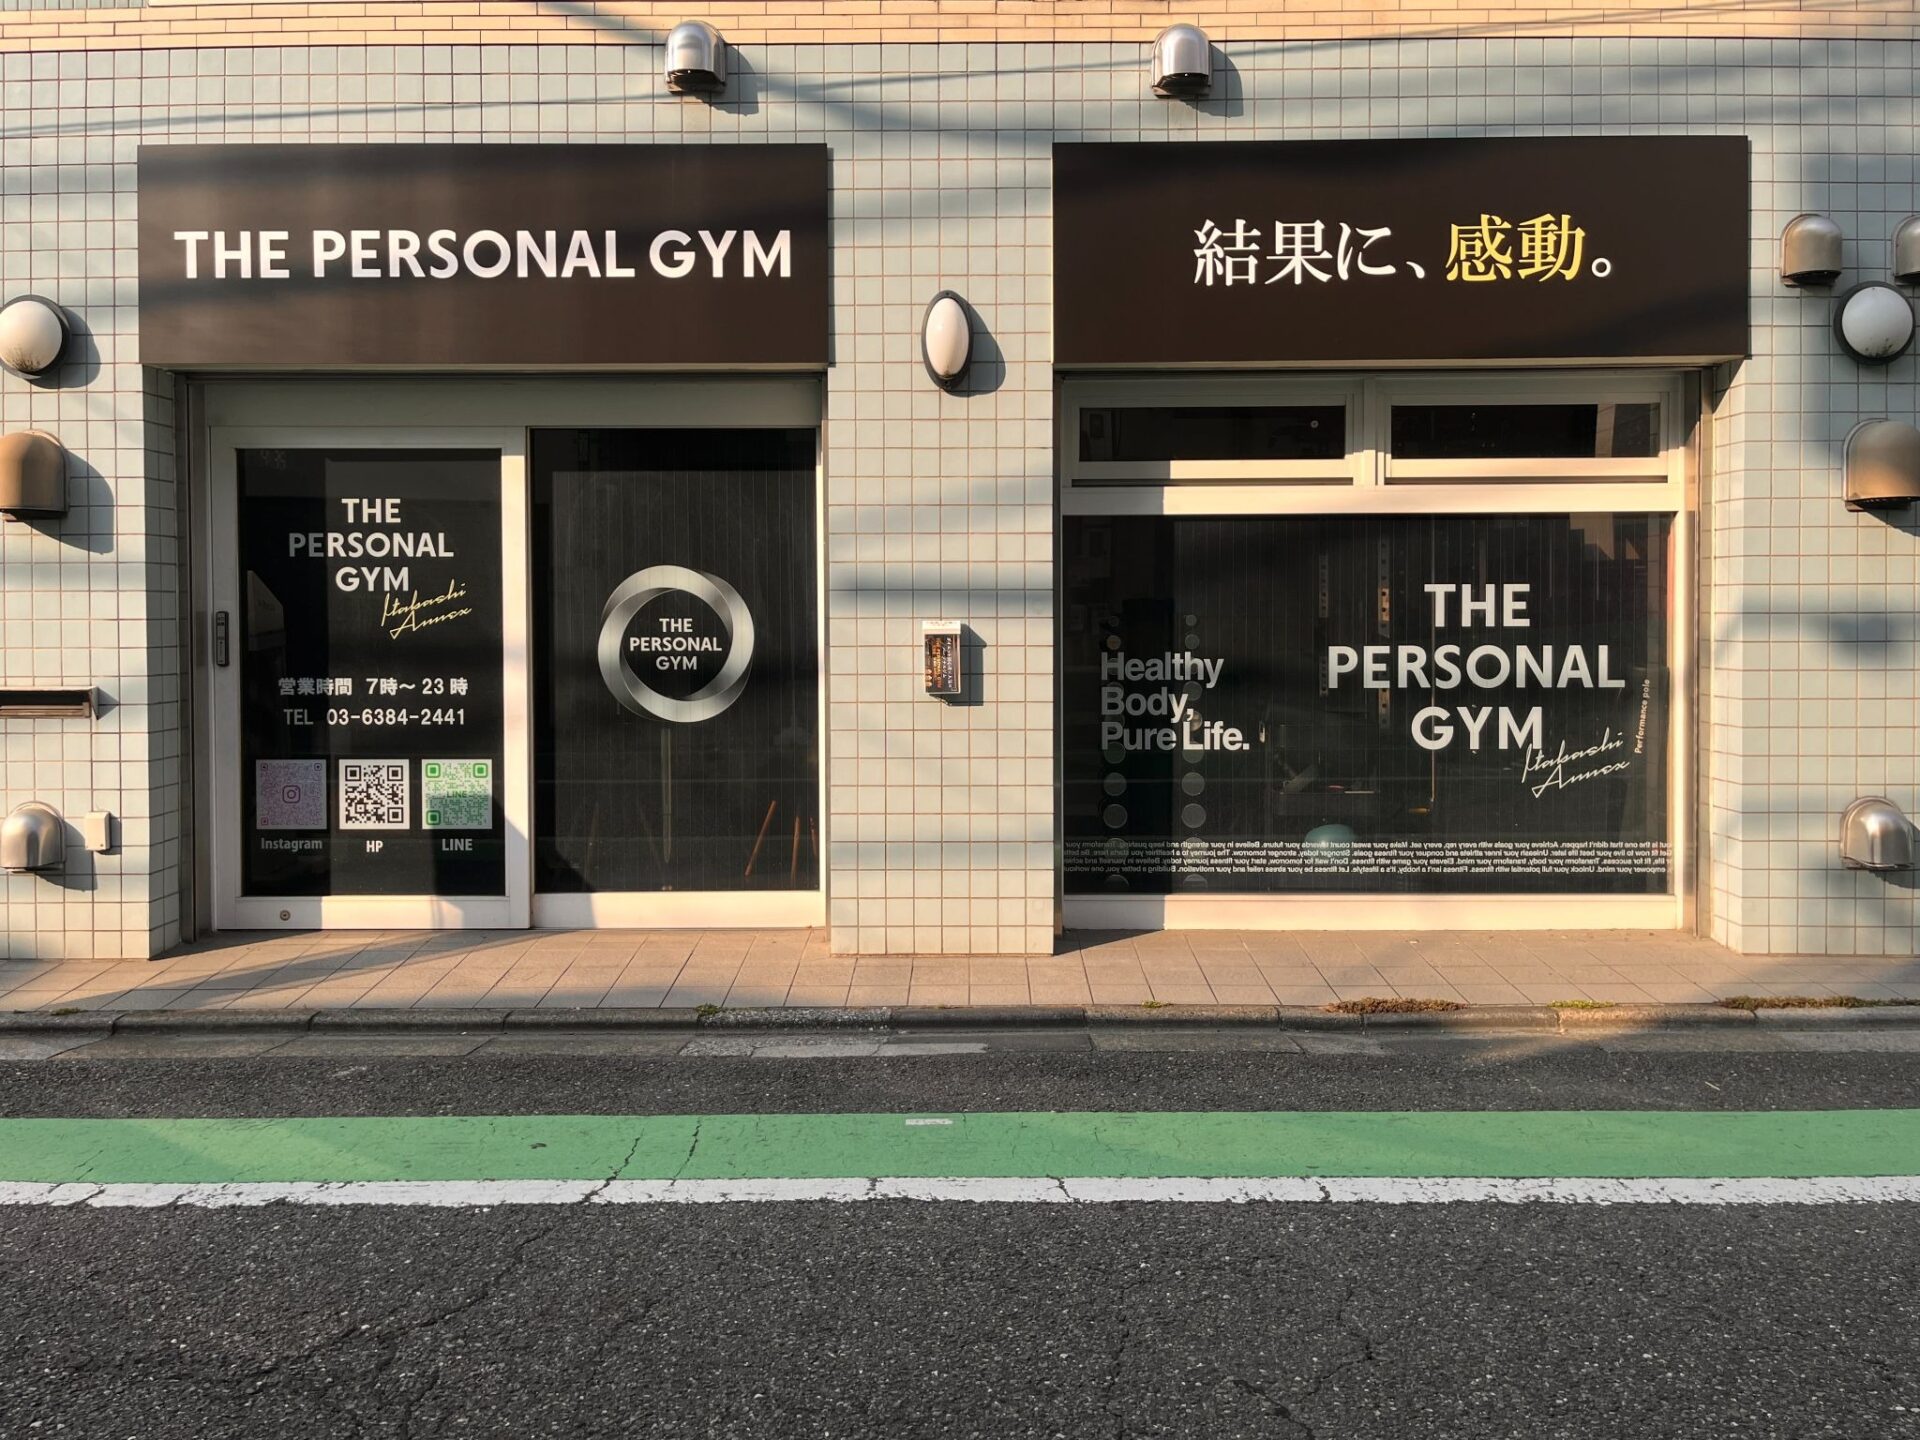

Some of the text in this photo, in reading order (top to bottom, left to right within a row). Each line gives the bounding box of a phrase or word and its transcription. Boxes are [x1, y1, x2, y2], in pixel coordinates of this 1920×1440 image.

[174, 230, 790, 278] THE PERSONAL GYM
[1194, 214, 1611, 286] 結果に、感動。
[342, 499, 401, 523] THE
[290, 532, 454, 558] PERSONAL
[336, 567, 408, 591] GYM
[1424, 584, 1530, 627] THE
[659, 619, 692, 632] THE
[630, 637, 722, 651] PERSONAL
[657, 656, 696, 669] GYM
[1102, 651, 1224, 689] Healthy
[1329, 645, 1625, 688] PERSONAL
[279, 678, 352, 696] 営業時間
[1102, 687, 1194, 721] Body,
[284, 709, 463, 725] TEL 03-6384-2441
[1412, 706, 1542, 749] GYM
[1634, 679, 1651, 754] Performance pole
[1102, 721, 1250, 751] Pure Life.
[446, 791, 468, 799] LINE
[262, 838, 322, 852] Instagram
[366, 840, 383, 852] HP
[441, 838, 473, 852] LINE
